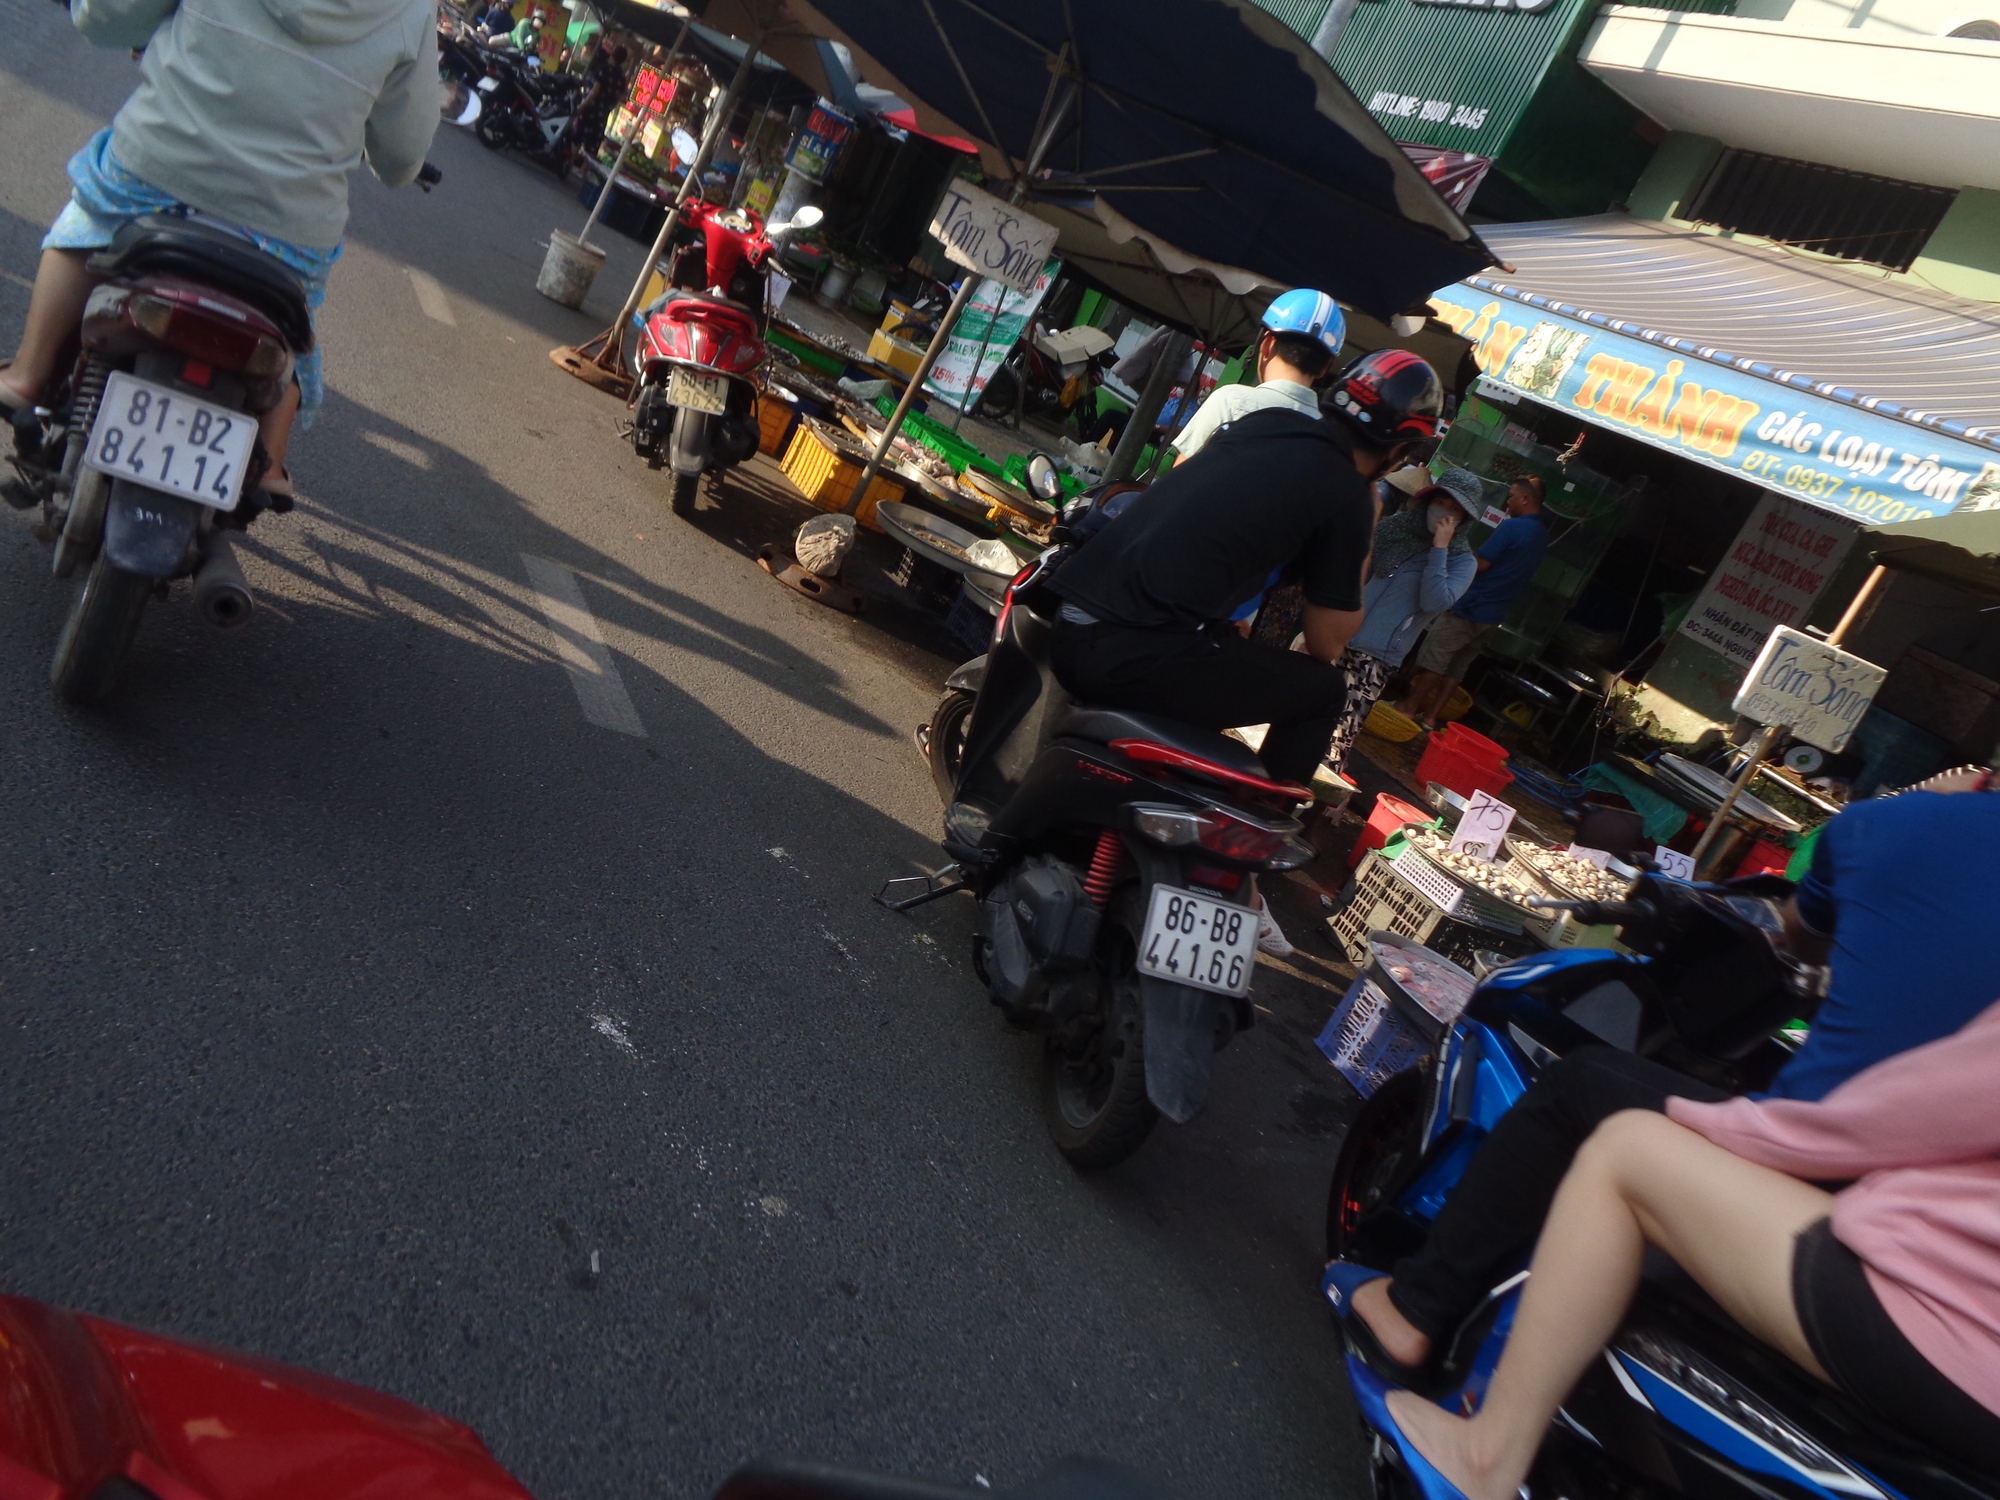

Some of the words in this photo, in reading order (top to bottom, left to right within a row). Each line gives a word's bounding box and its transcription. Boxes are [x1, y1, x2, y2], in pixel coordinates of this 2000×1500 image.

[1368, 90, 1420, 117] HOTLINE:
[1418, 99, 1452, 123] 1900
[1449, 104, 1489, 130] 3445
[941, 189, 986, 258] Tôm
[984, 219, 1044, 293] Sống
[680, 371, 719, 394] 60-F1
[932, 365, 955, 384] 15%
[127, 389, 232, 455] 81-B2
[100, 427, 230, 499] 841.14
[1756, 410, 1823, 453] CÁC
[1818, 430, 1895, 479] LOẠI
[1887, 453, 1973, 504] TÔM
[1785, 464, 1844, 499] 0937
[1685, 620, 1702, 635] ĐC:
[1701, 628, 1723, 647] 344A
[1702, 606, 1735, 628] NHẬN
[1731, 619, 1753, 640] ĐẶT
[1761, 635, 1812, 698] Tôm
[1809, 656, 1871, 747] Sống
[1470, 793, 1511, 831] 75
[1660, 852, 1692, 879] 55
[1165, 896, 1242, 946] 86-B8
[1146, 933, 1244, 989] 441.66
